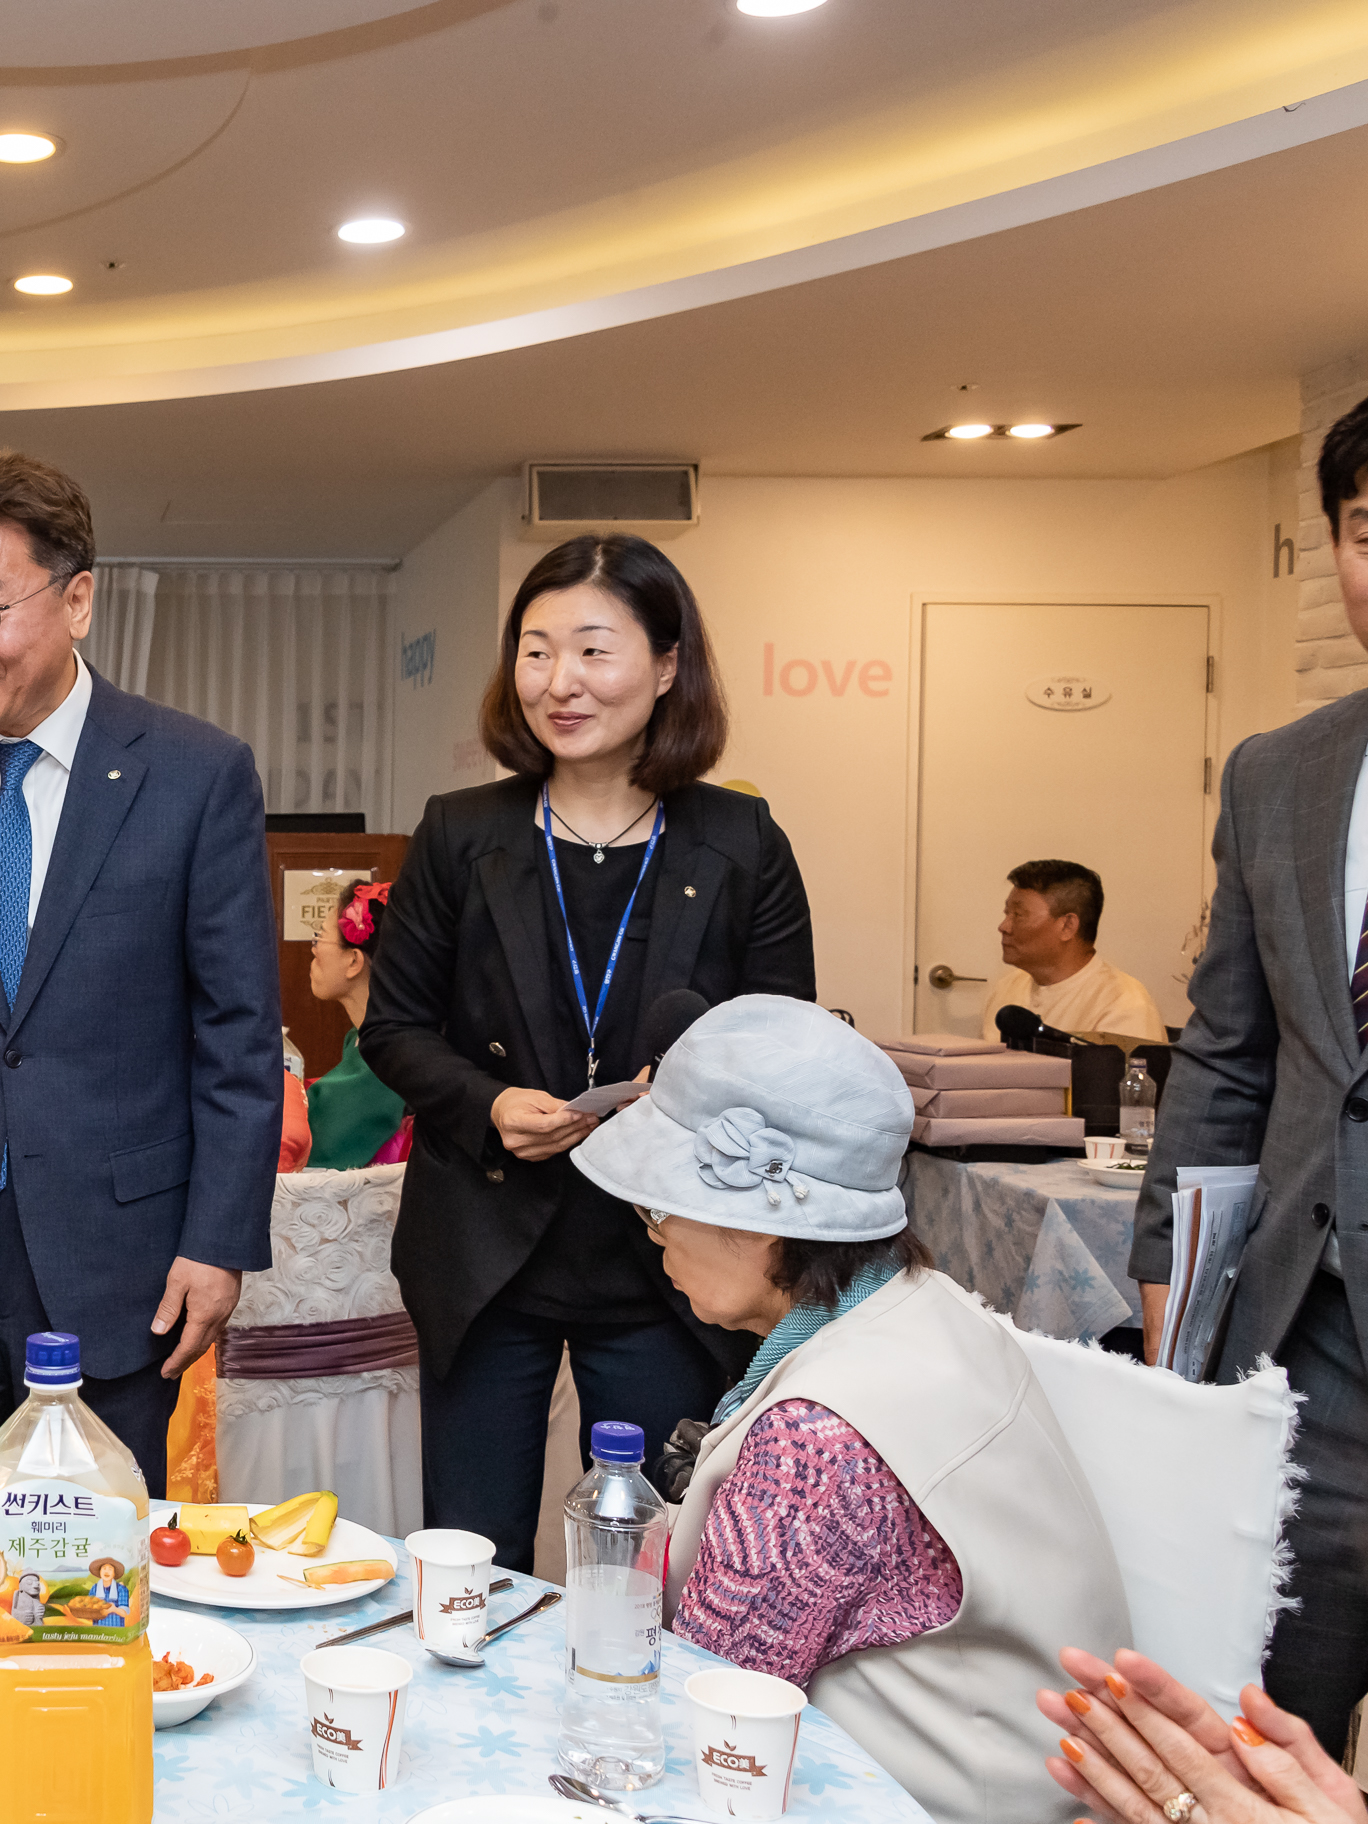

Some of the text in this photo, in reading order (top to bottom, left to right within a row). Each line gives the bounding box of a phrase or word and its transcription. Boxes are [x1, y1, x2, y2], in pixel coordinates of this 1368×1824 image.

[762, 642, 893, 698] love
[1, 1491, 96, 1517] 썬키스트
[31, 1520, 67, 1534] 훼미리
[8, 1536, 91, 1559] 제주감귤
[42, 1631, 125, 1643] tasty jeju mandarine
